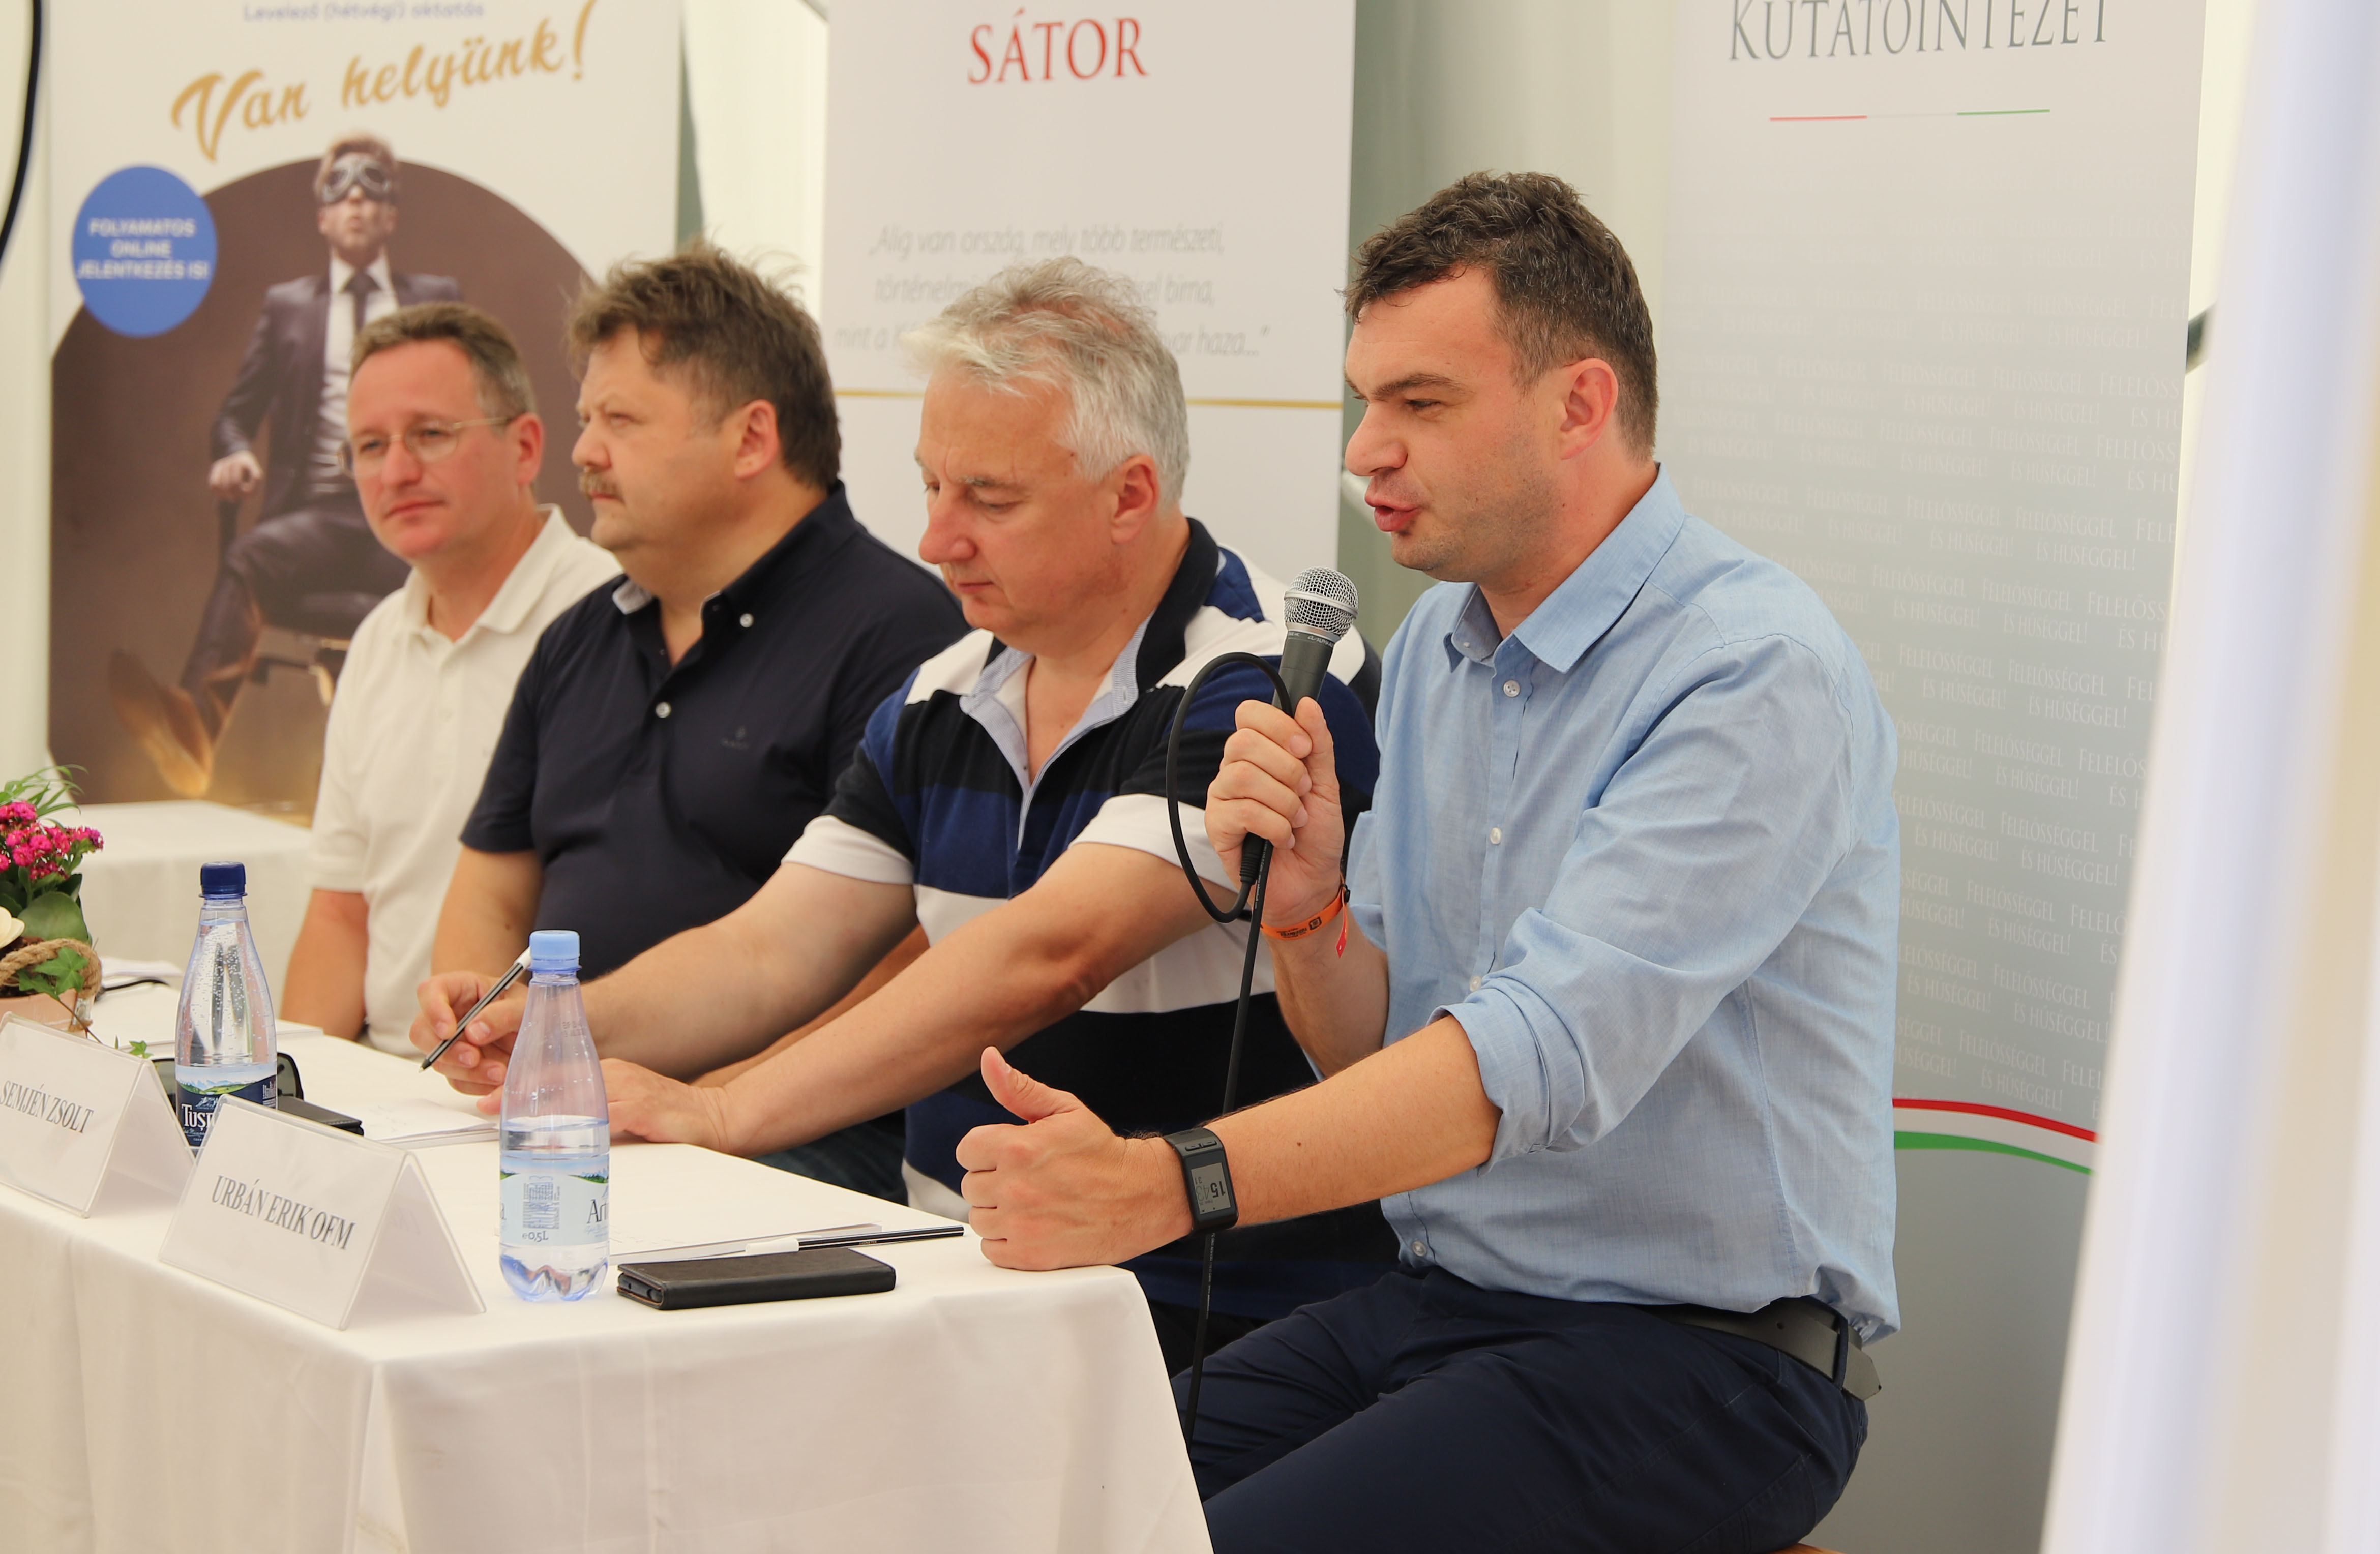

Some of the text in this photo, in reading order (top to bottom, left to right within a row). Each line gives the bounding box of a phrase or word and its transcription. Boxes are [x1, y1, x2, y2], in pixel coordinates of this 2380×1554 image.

[967, 8, 1150, 85] SÁTOR
[170, 0, 601, 163] Van helyünk!
[88, 218, 196, 238] FOLYAMATOS
[110, 238, 172, 258] ONLINE
[917, 230, 958, 254] van
[2036, 536, 2049, 562] ÉS
[2028, 691, 2041, 716] ÉS
[1995, 761, 2008, 786] ÉS
[2020, 843, 2033, 870] ÉS
[1988, 911, 2000, 938] ÉS
[1907, 970, 1920, 995] ÉS
[2013, 998, 2026, 1024] ÉS
[1980, 1064, 1993, 1089] ÉS
[0, 1080, 95, 1134] SEMJÉN ZSOLT
[212, 1175, 356, 1250] URBÁN ERIK OFM
